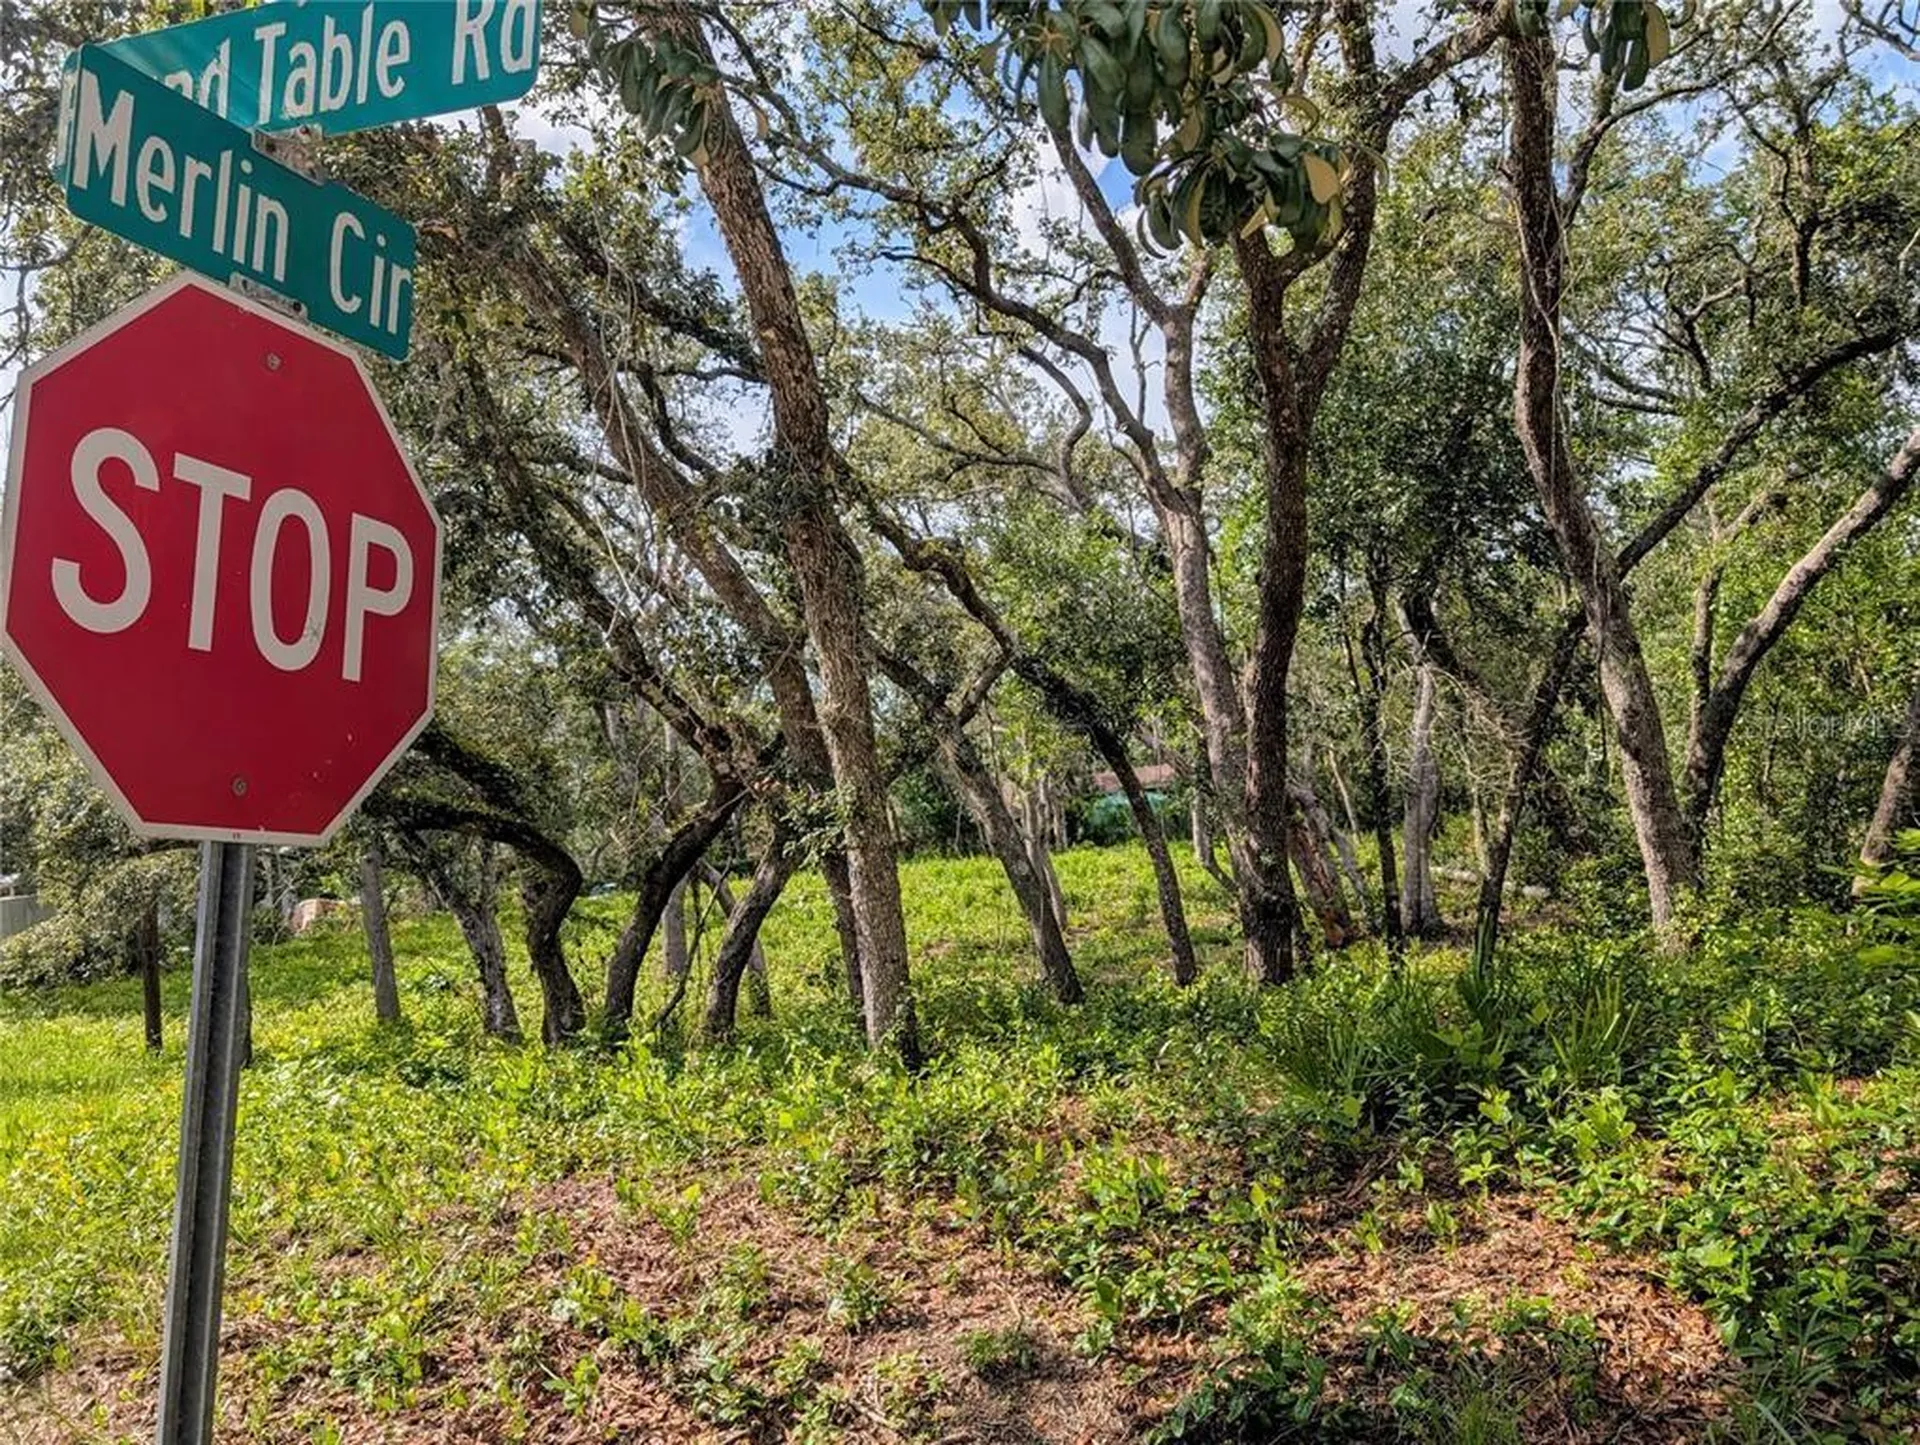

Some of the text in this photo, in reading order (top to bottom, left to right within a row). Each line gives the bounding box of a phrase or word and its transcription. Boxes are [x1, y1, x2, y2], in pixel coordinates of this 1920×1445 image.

[254, 2, 411, 124] Table
[451, 0, 537, 86] Rd
[73, 68, 290, 283] Merlin
[329, 210, 412, 335] Cir
[51, 427, 414, 682] STOP
